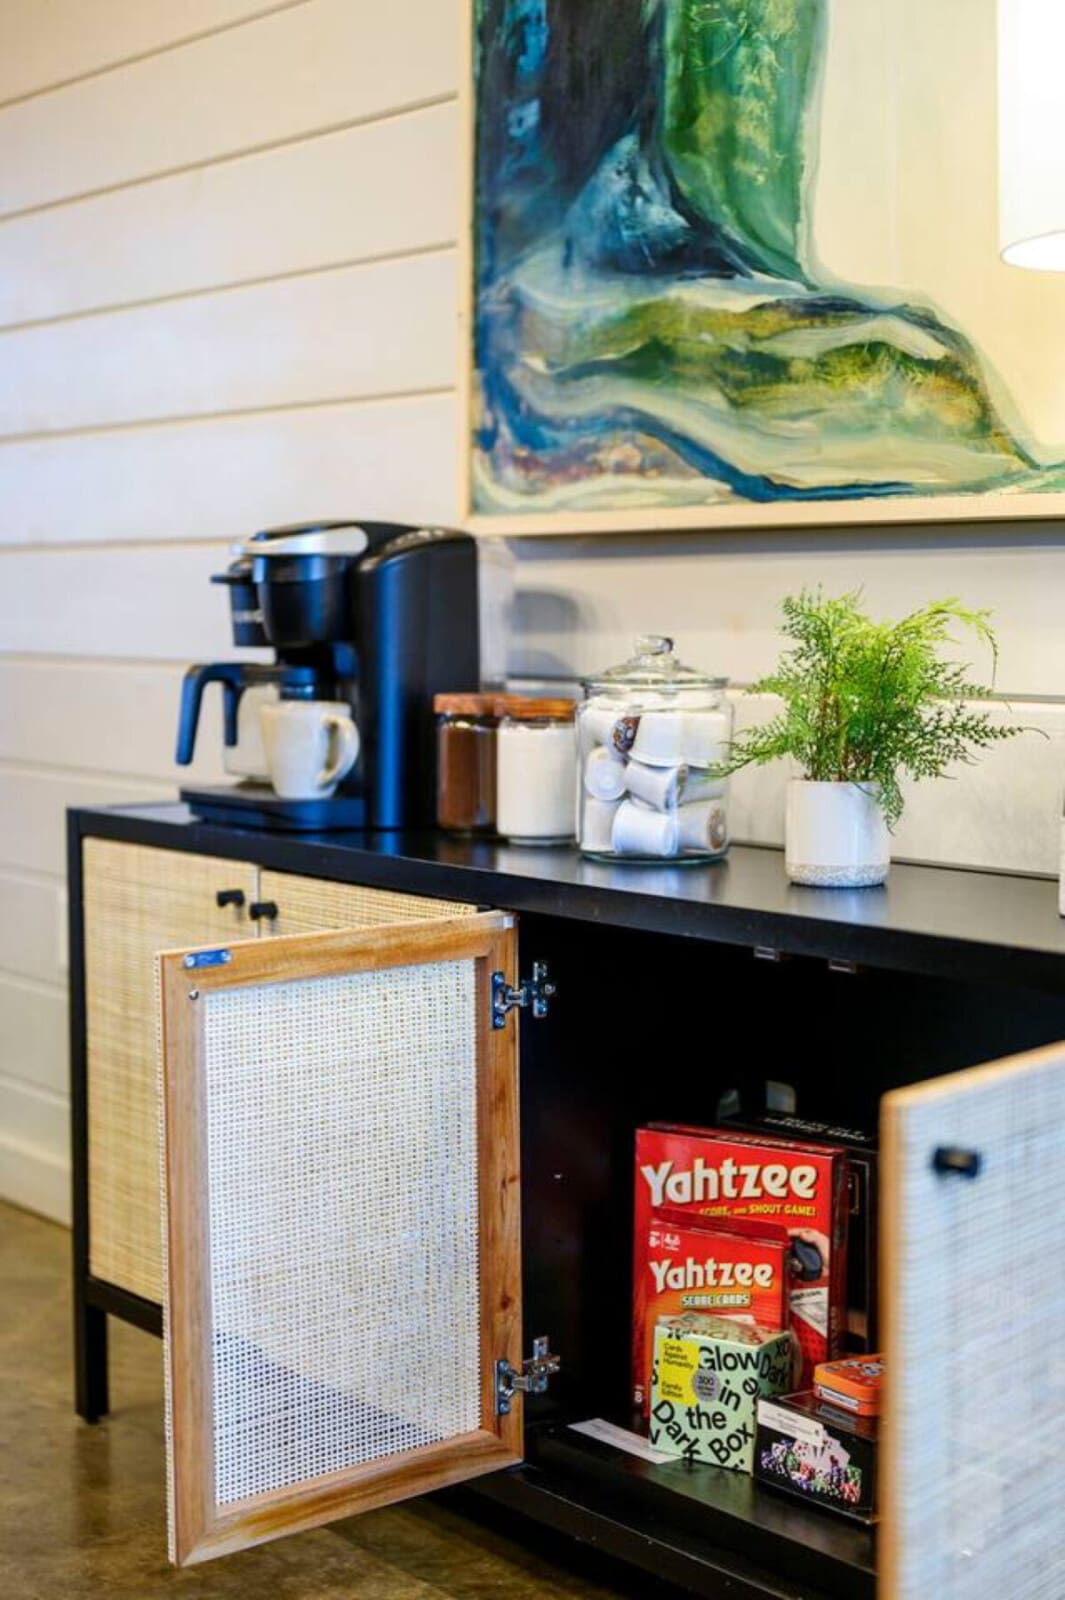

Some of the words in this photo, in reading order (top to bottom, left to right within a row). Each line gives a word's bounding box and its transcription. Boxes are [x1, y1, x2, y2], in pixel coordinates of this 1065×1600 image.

[640, 1157, 817, 1207] Yahtzee
[748, 1203, 782, 1214] SHOUT
[783, 1204, 816, 1216] GAME!
[648, 1257, 773, 1294] Yahtzee
[698, 1345, 761, 1372] Glow
[719, 1379, 741, 1411] in
[685, 1404, 727, 1430] the
[708, 1423, 754, 1464] Box
